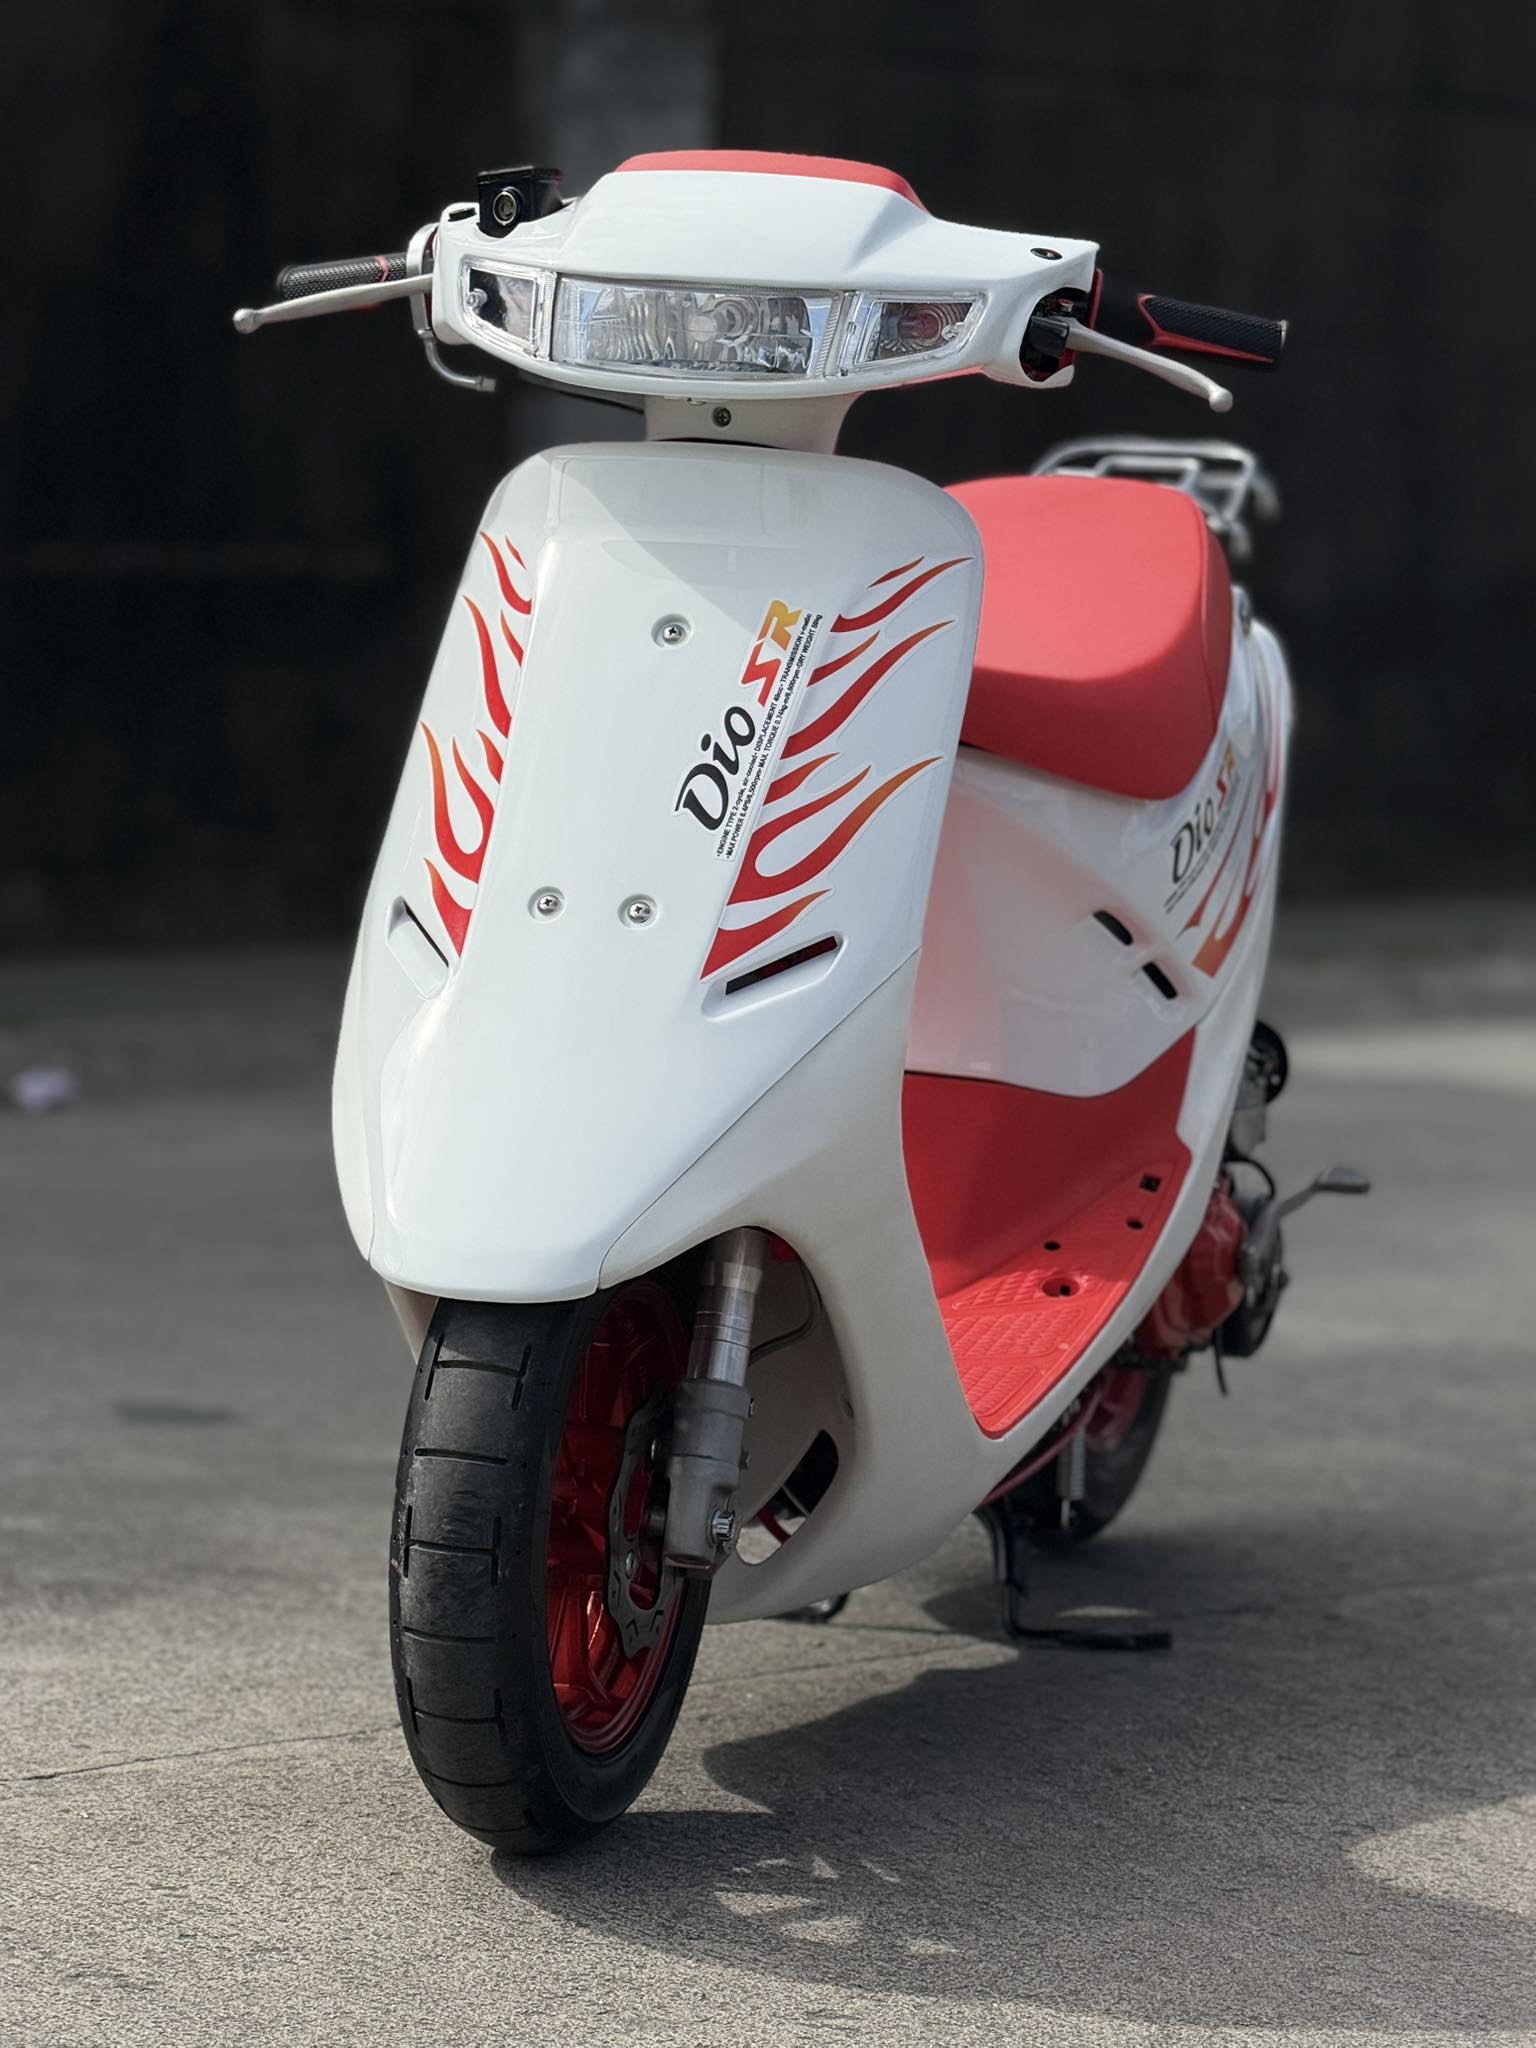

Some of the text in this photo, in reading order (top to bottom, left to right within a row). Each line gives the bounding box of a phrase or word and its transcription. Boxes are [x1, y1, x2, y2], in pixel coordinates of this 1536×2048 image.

[674, 599, 802, 831] Dio SR
[716, 829, 730, 855] ENGINE
[726, 811, 736, 829] TYPE
[754, 702, 777, 752] DISPLACEMENT
[780, 635, 802, 682] TRANSMISSION
[731, 818, 744, 843] POWER
[764, 724, 780, 752] TORQUE
[803, 629, 816, 654] WEIGHT
[1170, 797, 1214, 884] Dio
